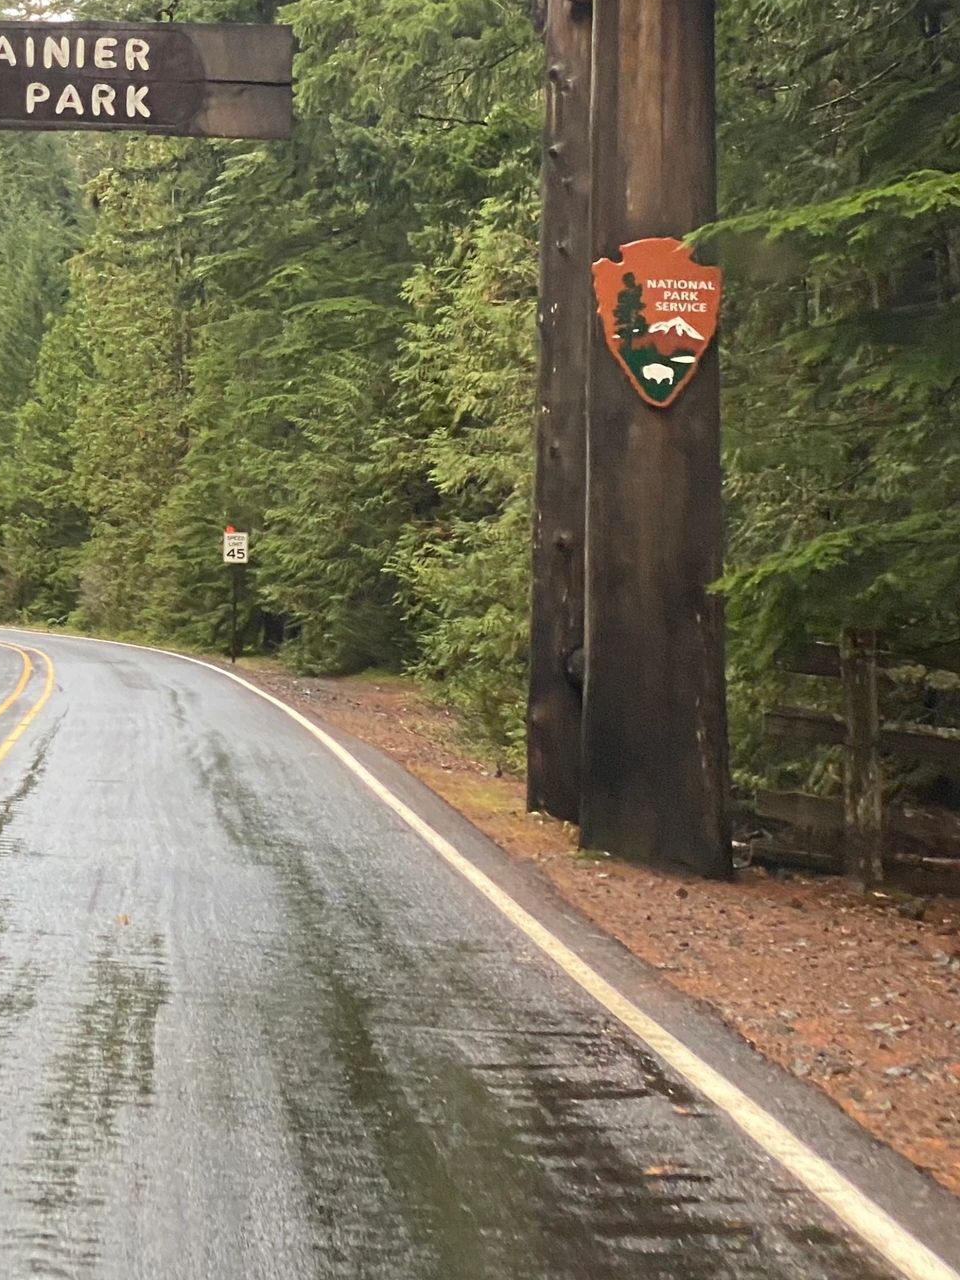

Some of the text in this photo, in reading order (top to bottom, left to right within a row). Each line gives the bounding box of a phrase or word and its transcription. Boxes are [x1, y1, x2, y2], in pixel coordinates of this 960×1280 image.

[26, 82, 151, 118] PARK
[647, 279, 715, 290] NATIONAL
[664, 291, 699, 301] PARK
[655, 302, 707, 312] SERVICE
[226, 548, 245, 559] 45
